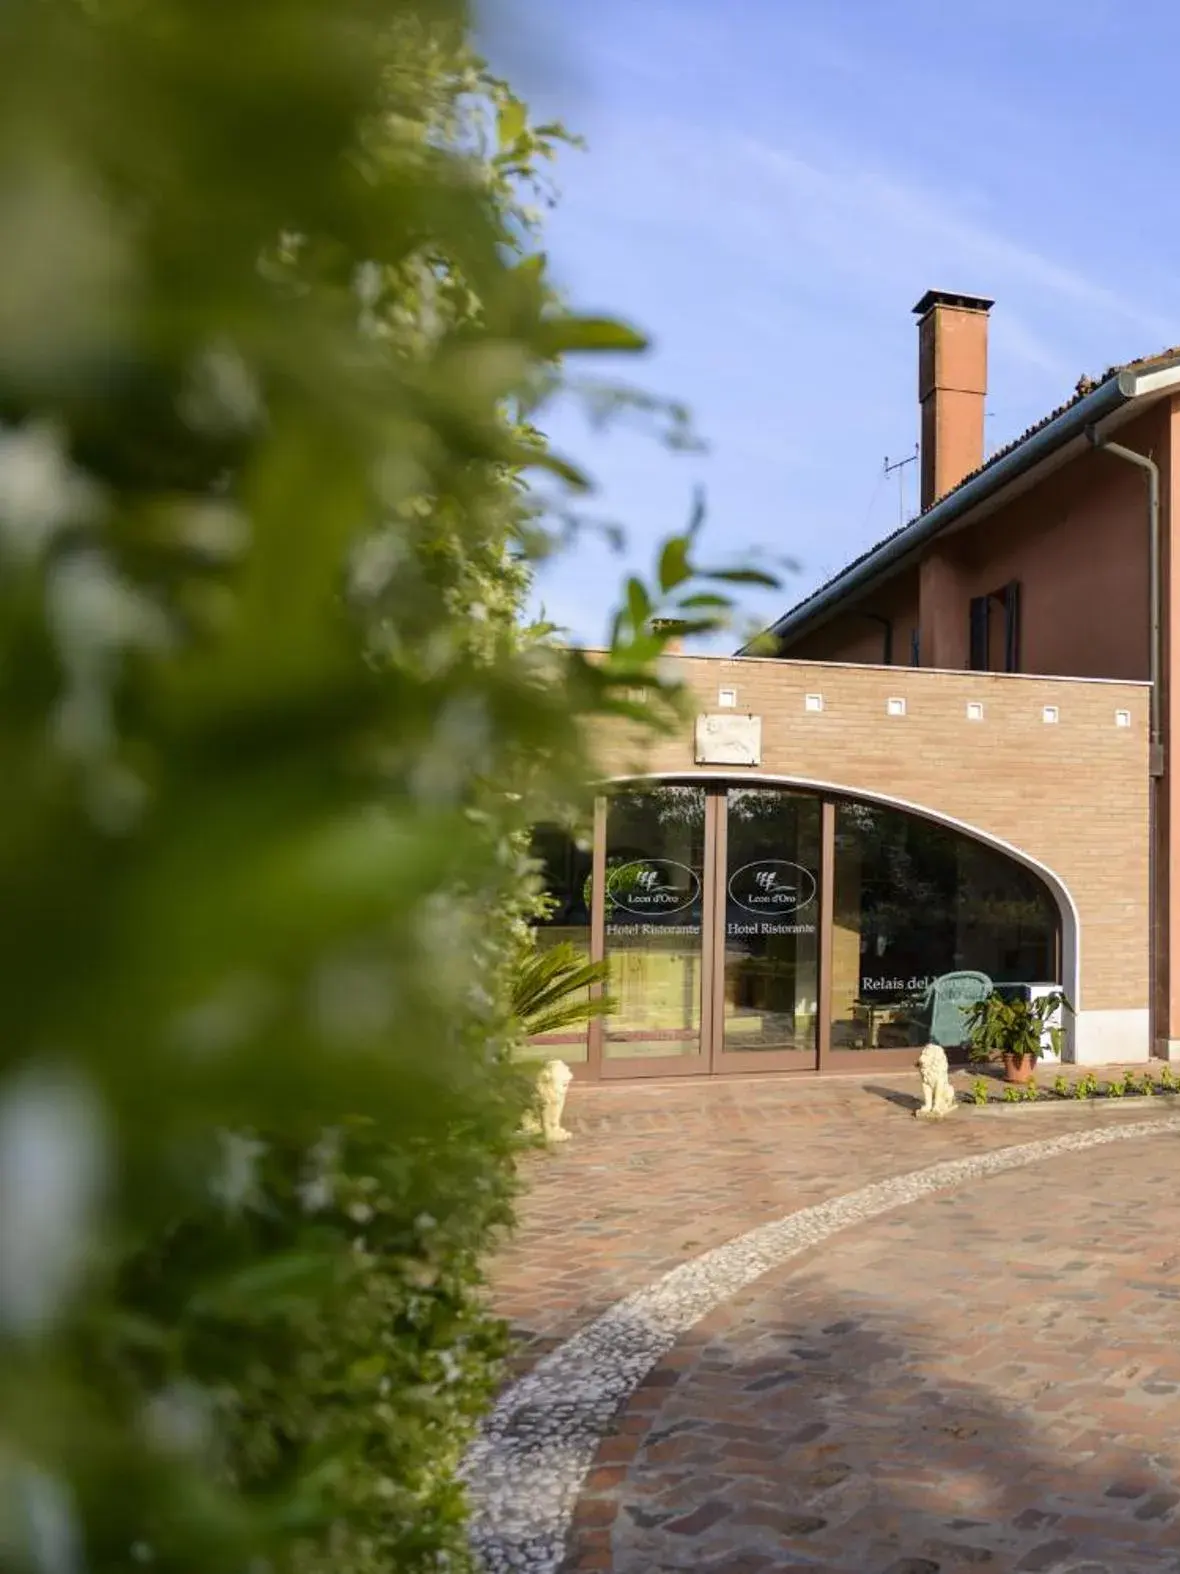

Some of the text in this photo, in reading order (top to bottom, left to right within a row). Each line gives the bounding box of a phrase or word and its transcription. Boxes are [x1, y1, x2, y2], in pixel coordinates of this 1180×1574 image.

[628, 893, 679, 903] Leon d'Oro
[748, 893, 796, 903] Leon d'Oro
[606, 924, 700, 936] Hotel Ristorante
[727, 923, 816, 935] Hotel Ristorante
[862, 976, 904, 990] Relais
